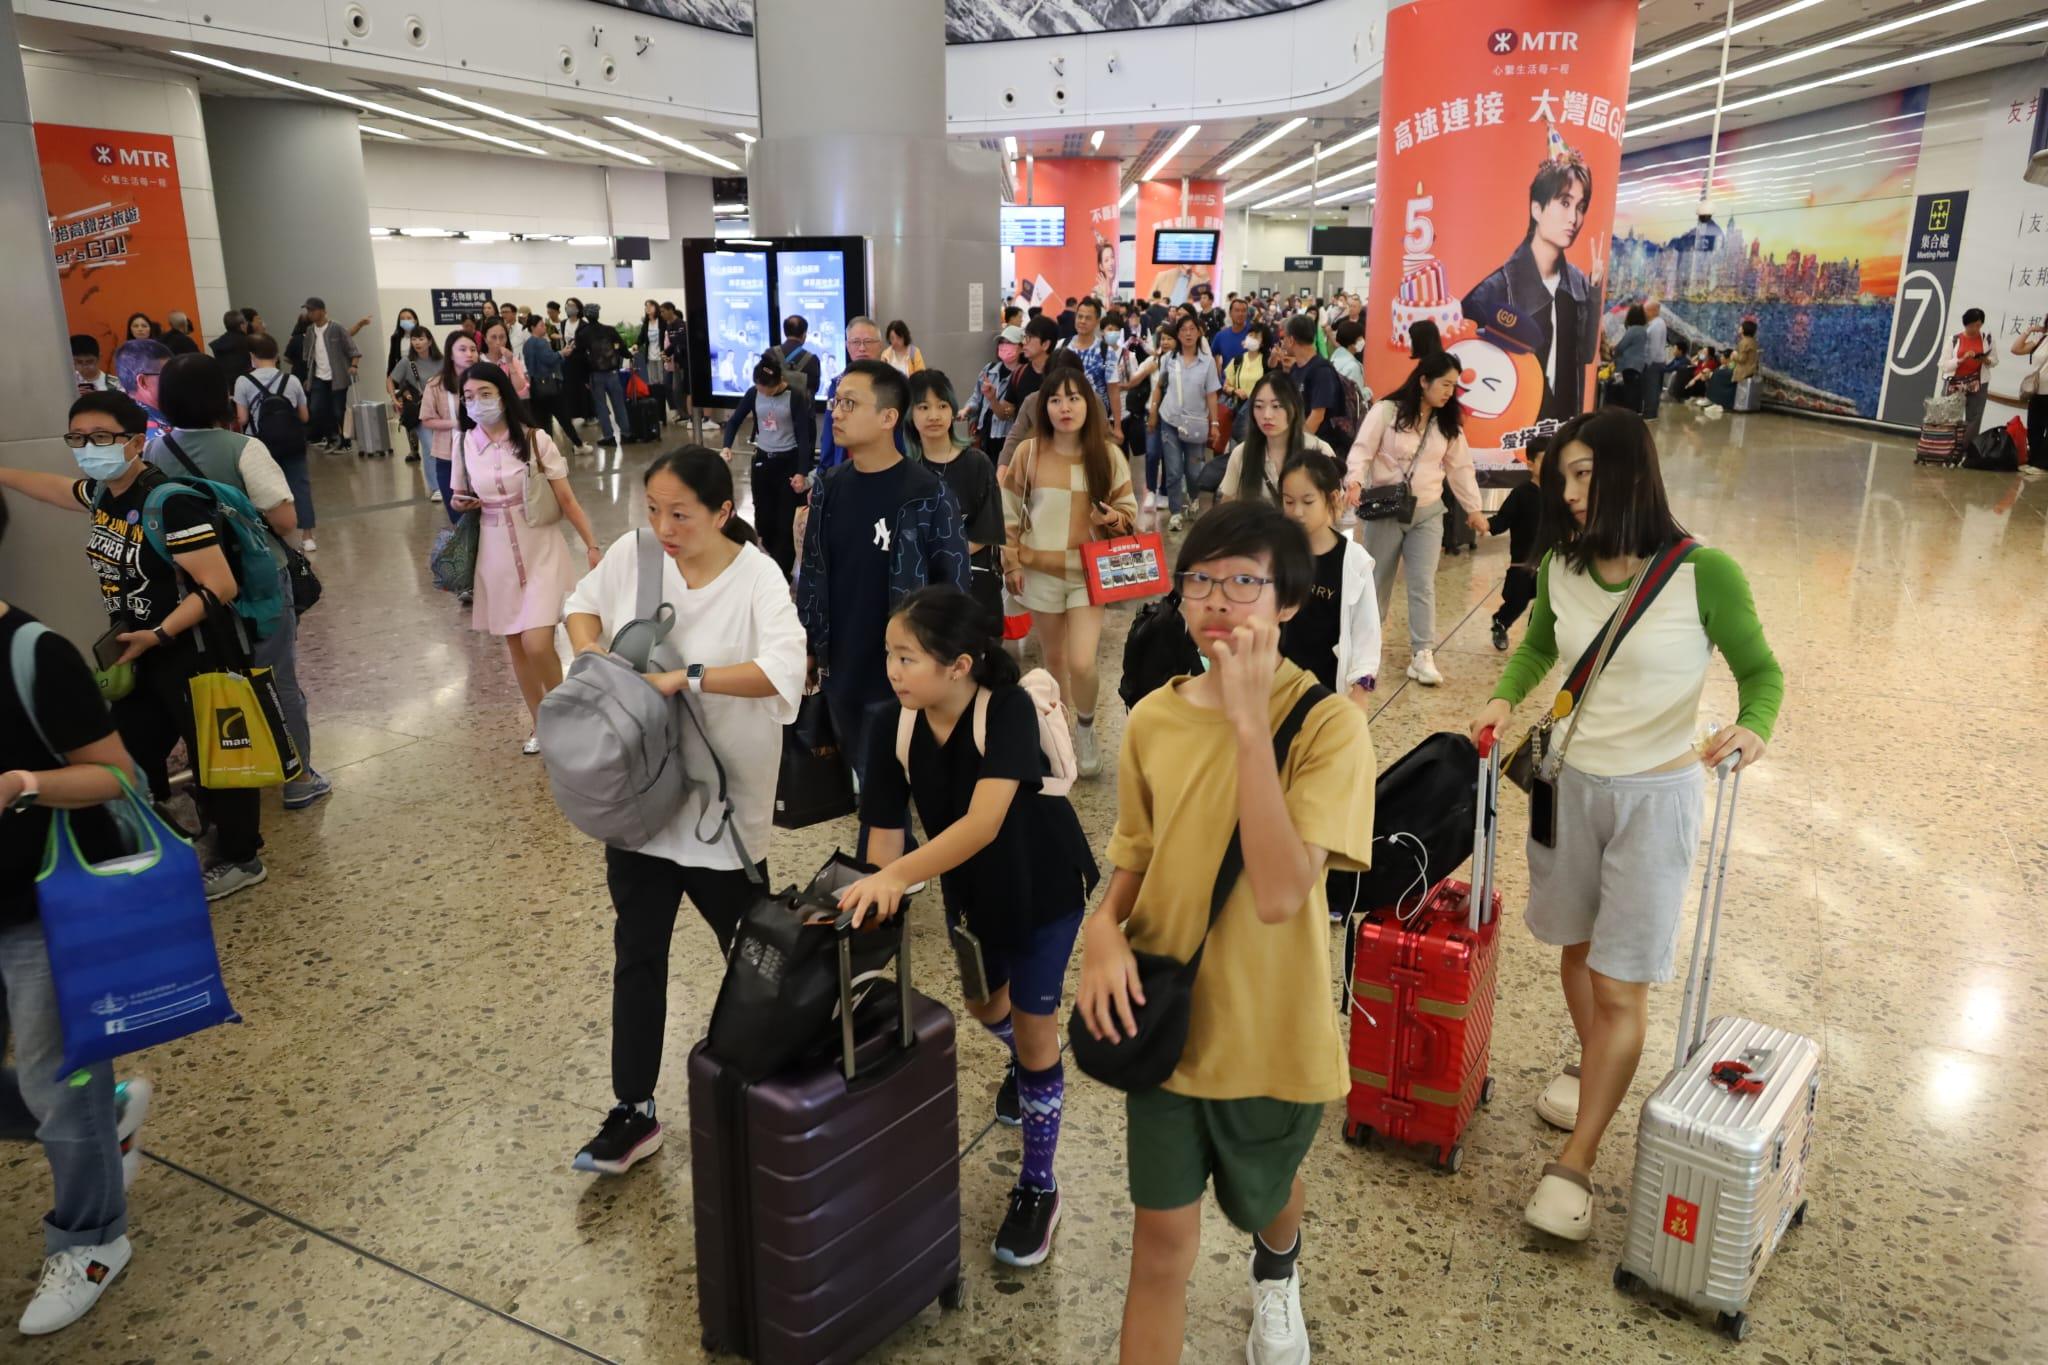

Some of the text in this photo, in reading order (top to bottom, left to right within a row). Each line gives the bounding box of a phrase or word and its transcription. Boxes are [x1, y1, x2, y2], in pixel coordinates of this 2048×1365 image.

[1521, 31, 1578, 51] MTR
[1393, 91, 1504, 155] 高速連接
[119, 148, 170, 168] MTR
[51, 207, 140, 245] 搭高鐵去旅遊
[1403, 194, 1434, 255] 5
[1921, 233, 1950, 249] 集合處
[1897, 289, 1933, 359] 7
[1500, 419, 1560, 450] 愛搭高
